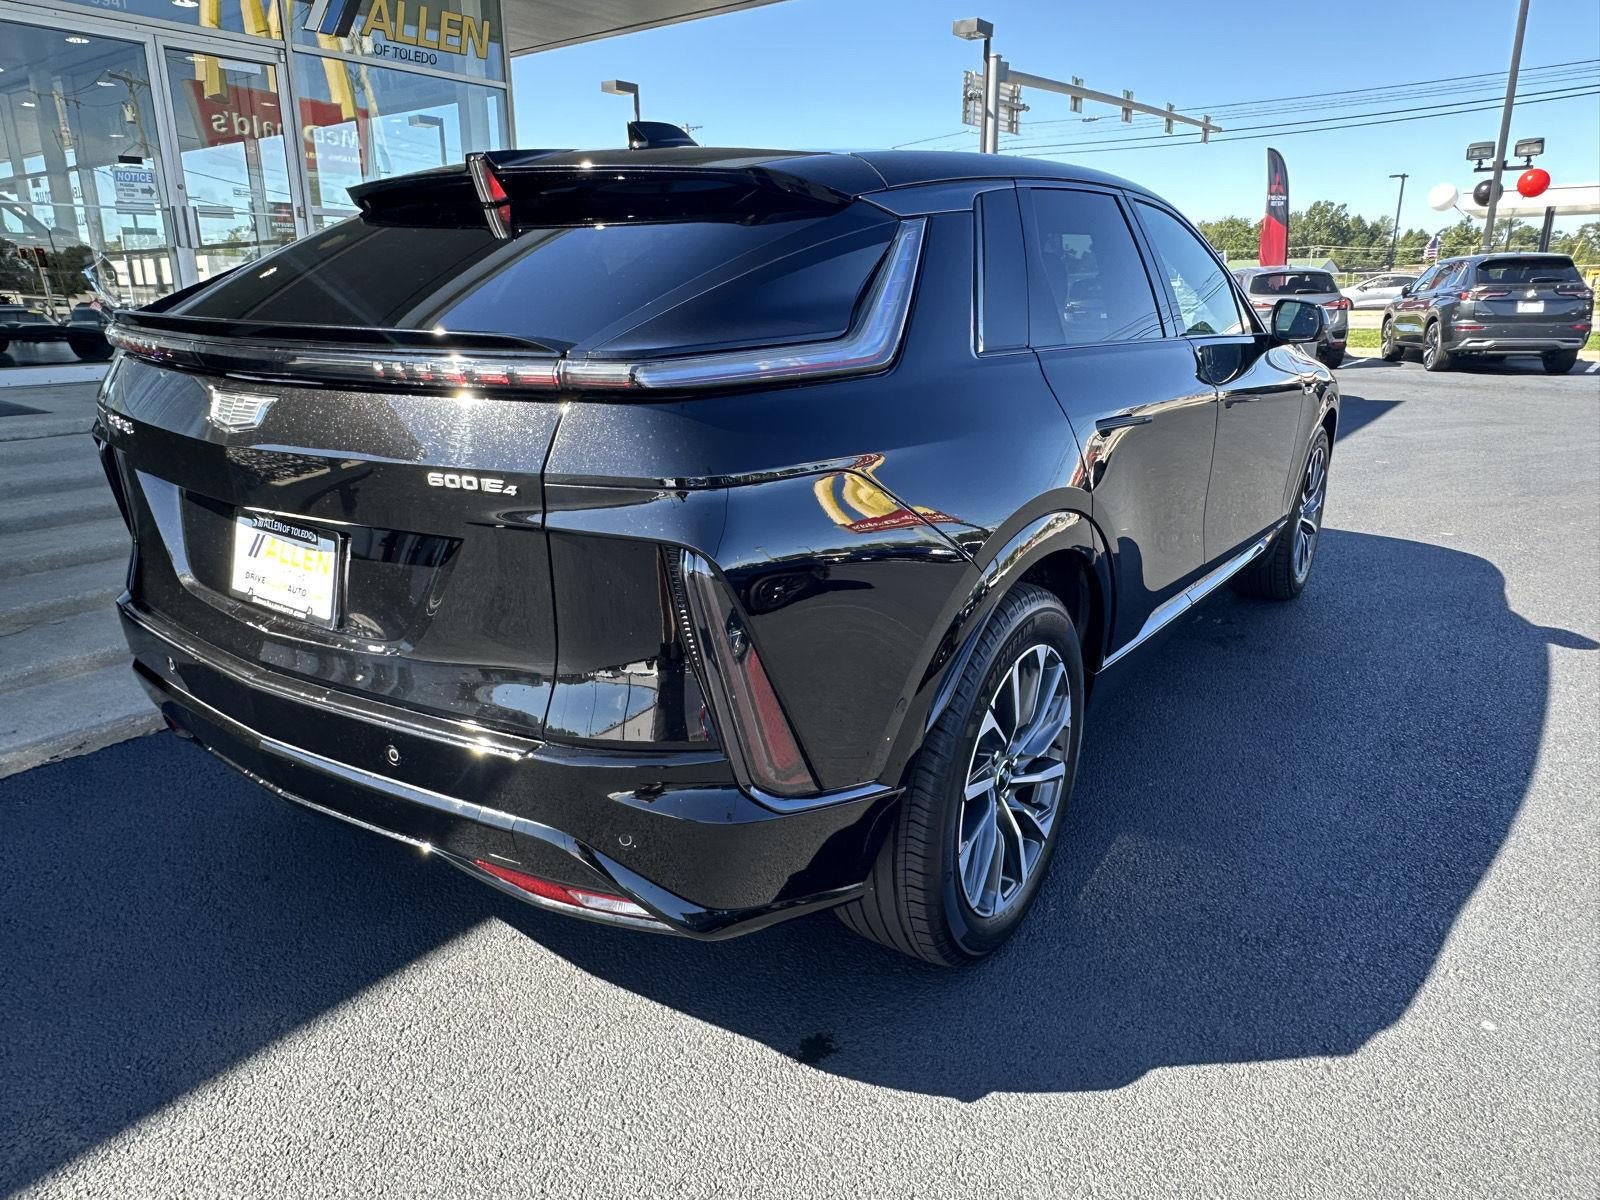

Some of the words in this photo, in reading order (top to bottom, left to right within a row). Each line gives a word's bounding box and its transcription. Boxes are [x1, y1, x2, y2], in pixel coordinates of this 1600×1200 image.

[362, 0, 490, 59] ALLEN
[373, 42, 390, 57] OF
[392, 46, 438, 65] TOLEDO
[117, 172, 152, 183] NOTICE
[264, 518, 282, 532] ALLEN
[282, 525, 290, 533] OF
[291, 527, 314, 540] TOLEDO
[265, 536, 331, 576] ALLEN
